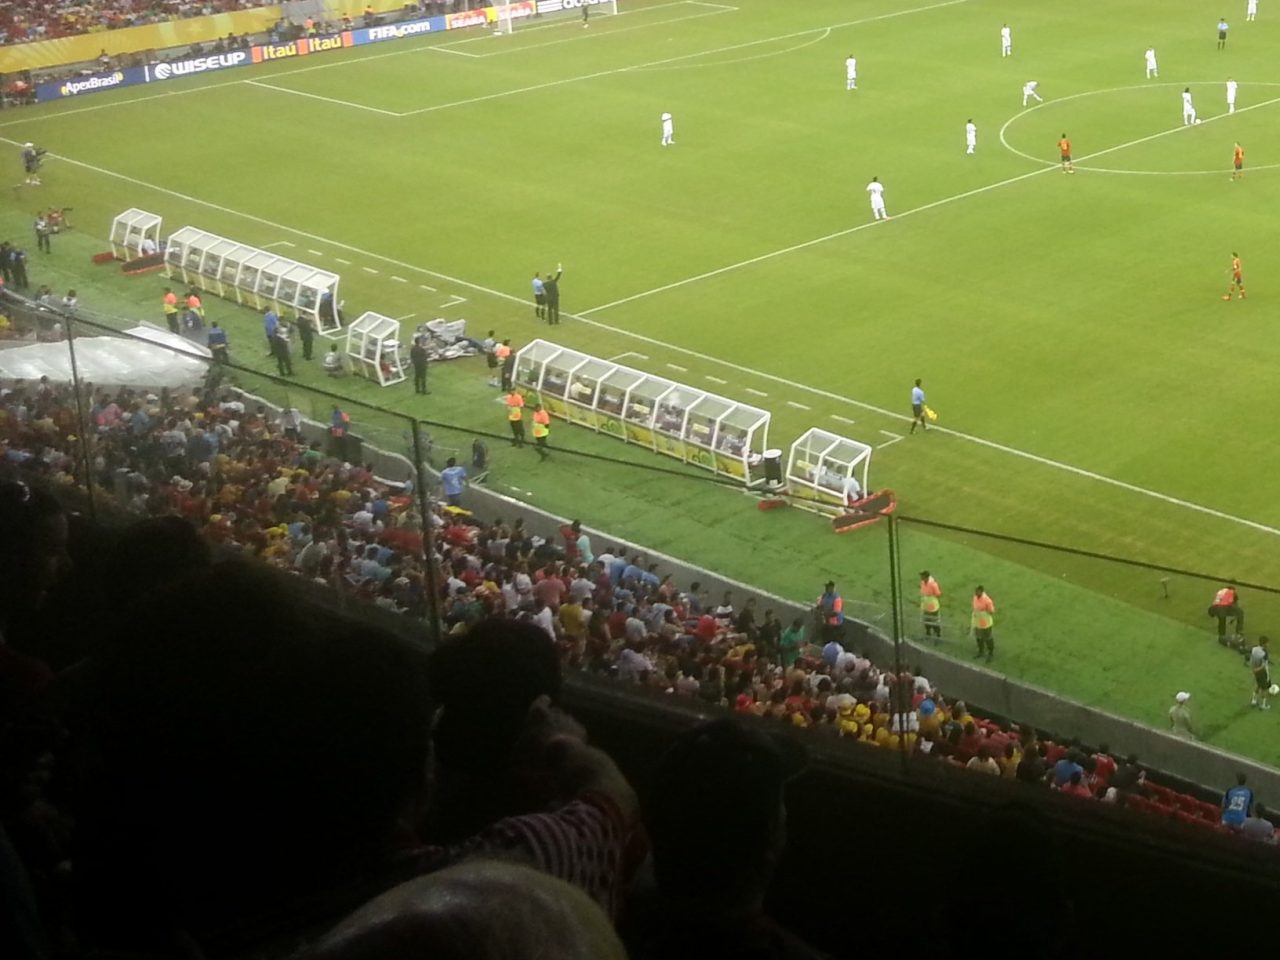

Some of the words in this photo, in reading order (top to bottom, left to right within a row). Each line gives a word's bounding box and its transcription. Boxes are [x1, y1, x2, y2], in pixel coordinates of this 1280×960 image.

[368, 20, 431, 41] FIFA.com
[263, 42, 297, 59] Itaú
[309, 35, 341, 52] Itaú
[65, 74, 120, 95] ApexBrasil
